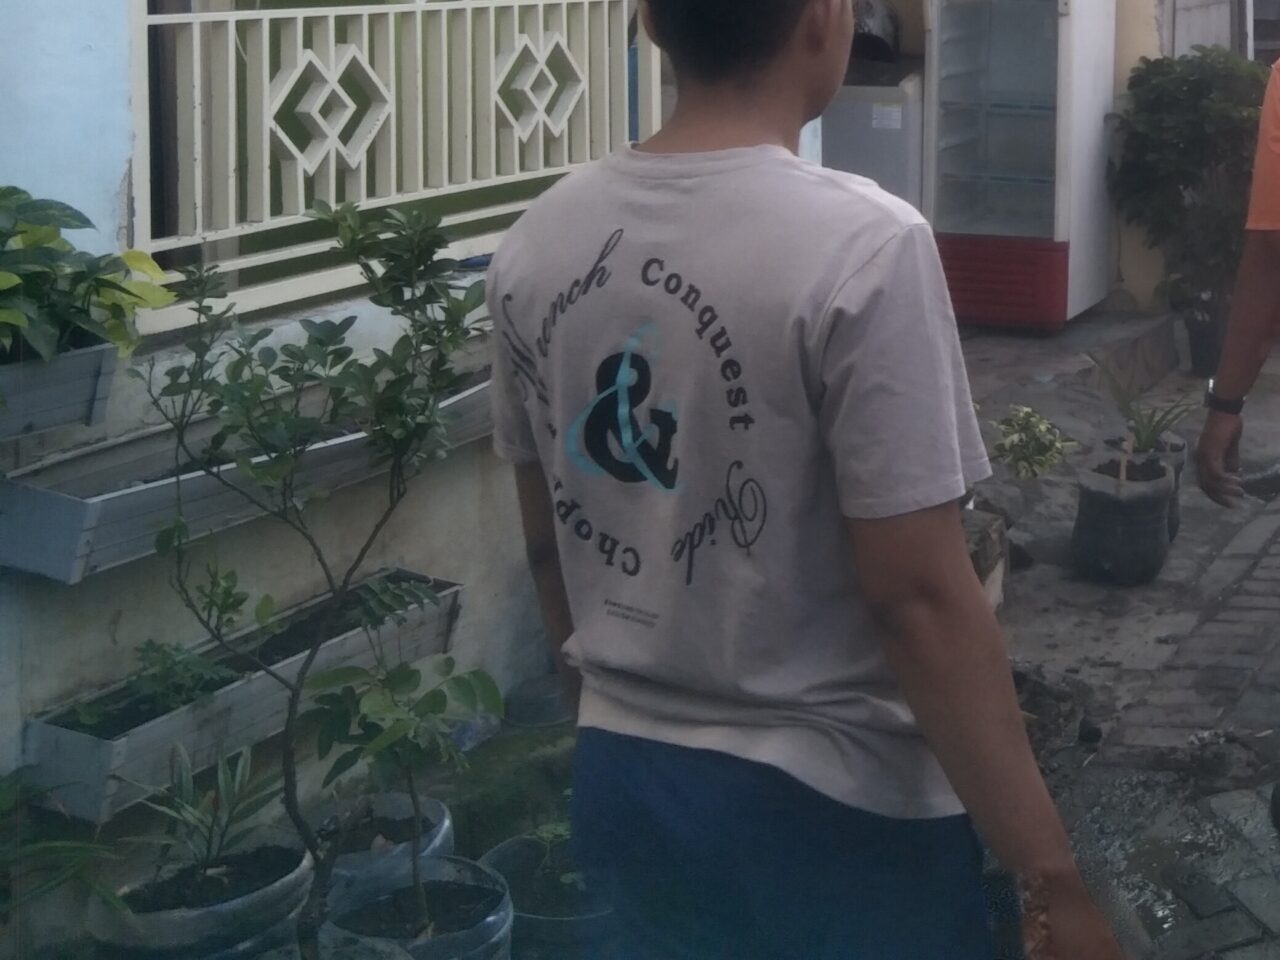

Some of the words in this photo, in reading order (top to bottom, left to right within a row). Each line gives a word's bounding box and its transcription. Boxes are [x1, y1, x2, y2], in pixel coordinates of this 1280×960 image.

[640, 257, 756, 432] Conquest
[583, 351, 680, 490] &
[670, 460, 767, 586] Ride
